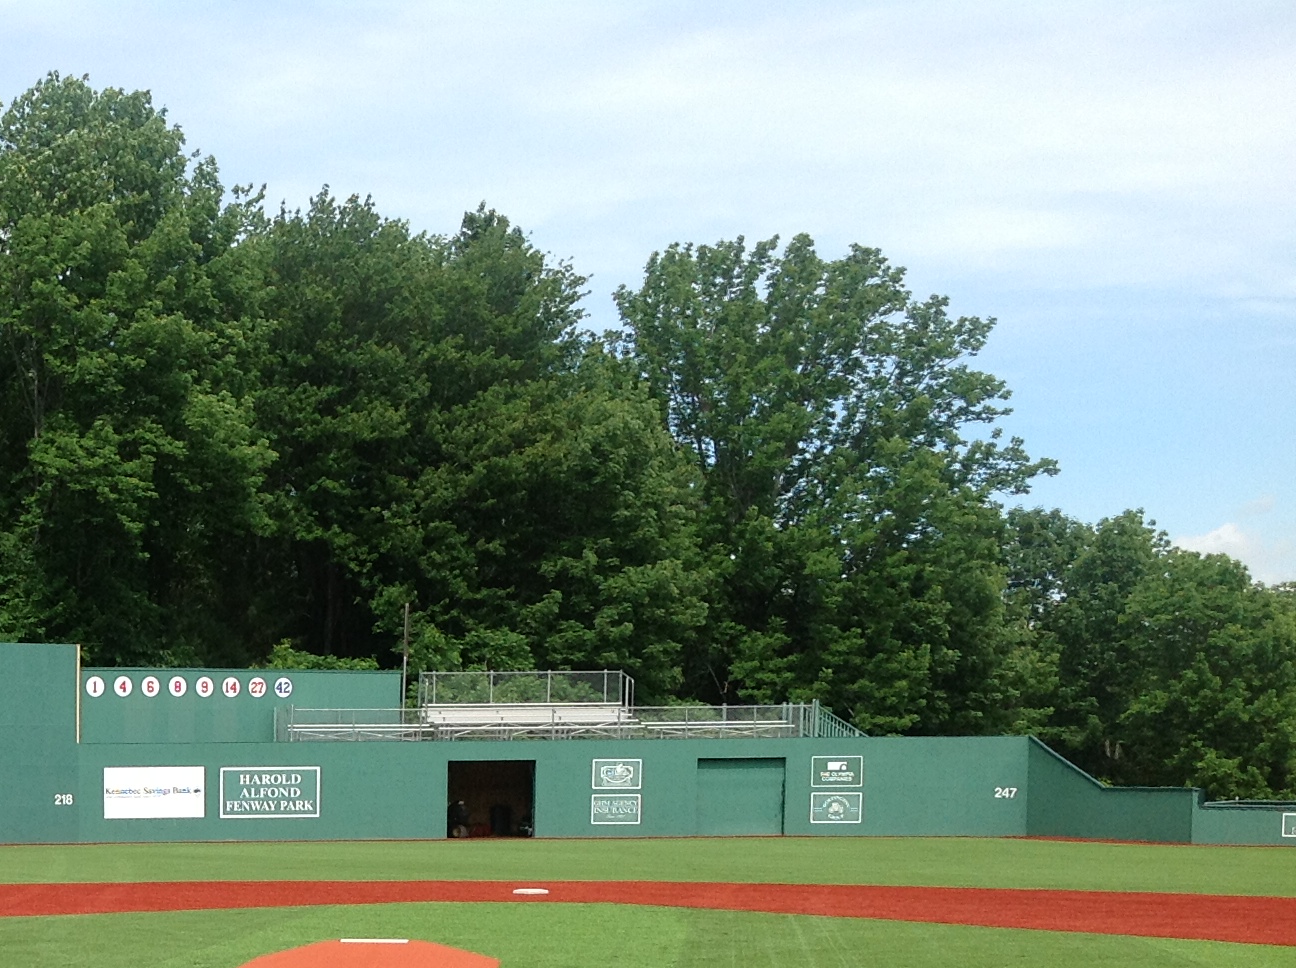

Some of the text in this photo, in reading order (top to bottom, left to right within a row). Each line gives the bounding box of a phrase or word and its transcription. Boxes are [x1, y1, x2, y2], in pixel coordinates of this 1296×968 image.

[92, 681, 290, 694] 1 4 6 8 9 14 27 42
[239, 773, 302, 785] HAROLD
[143, 787, 171, 796] Savings
[172, 787, 192, 795] Bank
[239, 787, 301, 799] ALFOND
[994, 787, 1018, 799] 247
[54, 794, 74, 806] 218
[226, 800, 314, 812] FENWAY PARK
